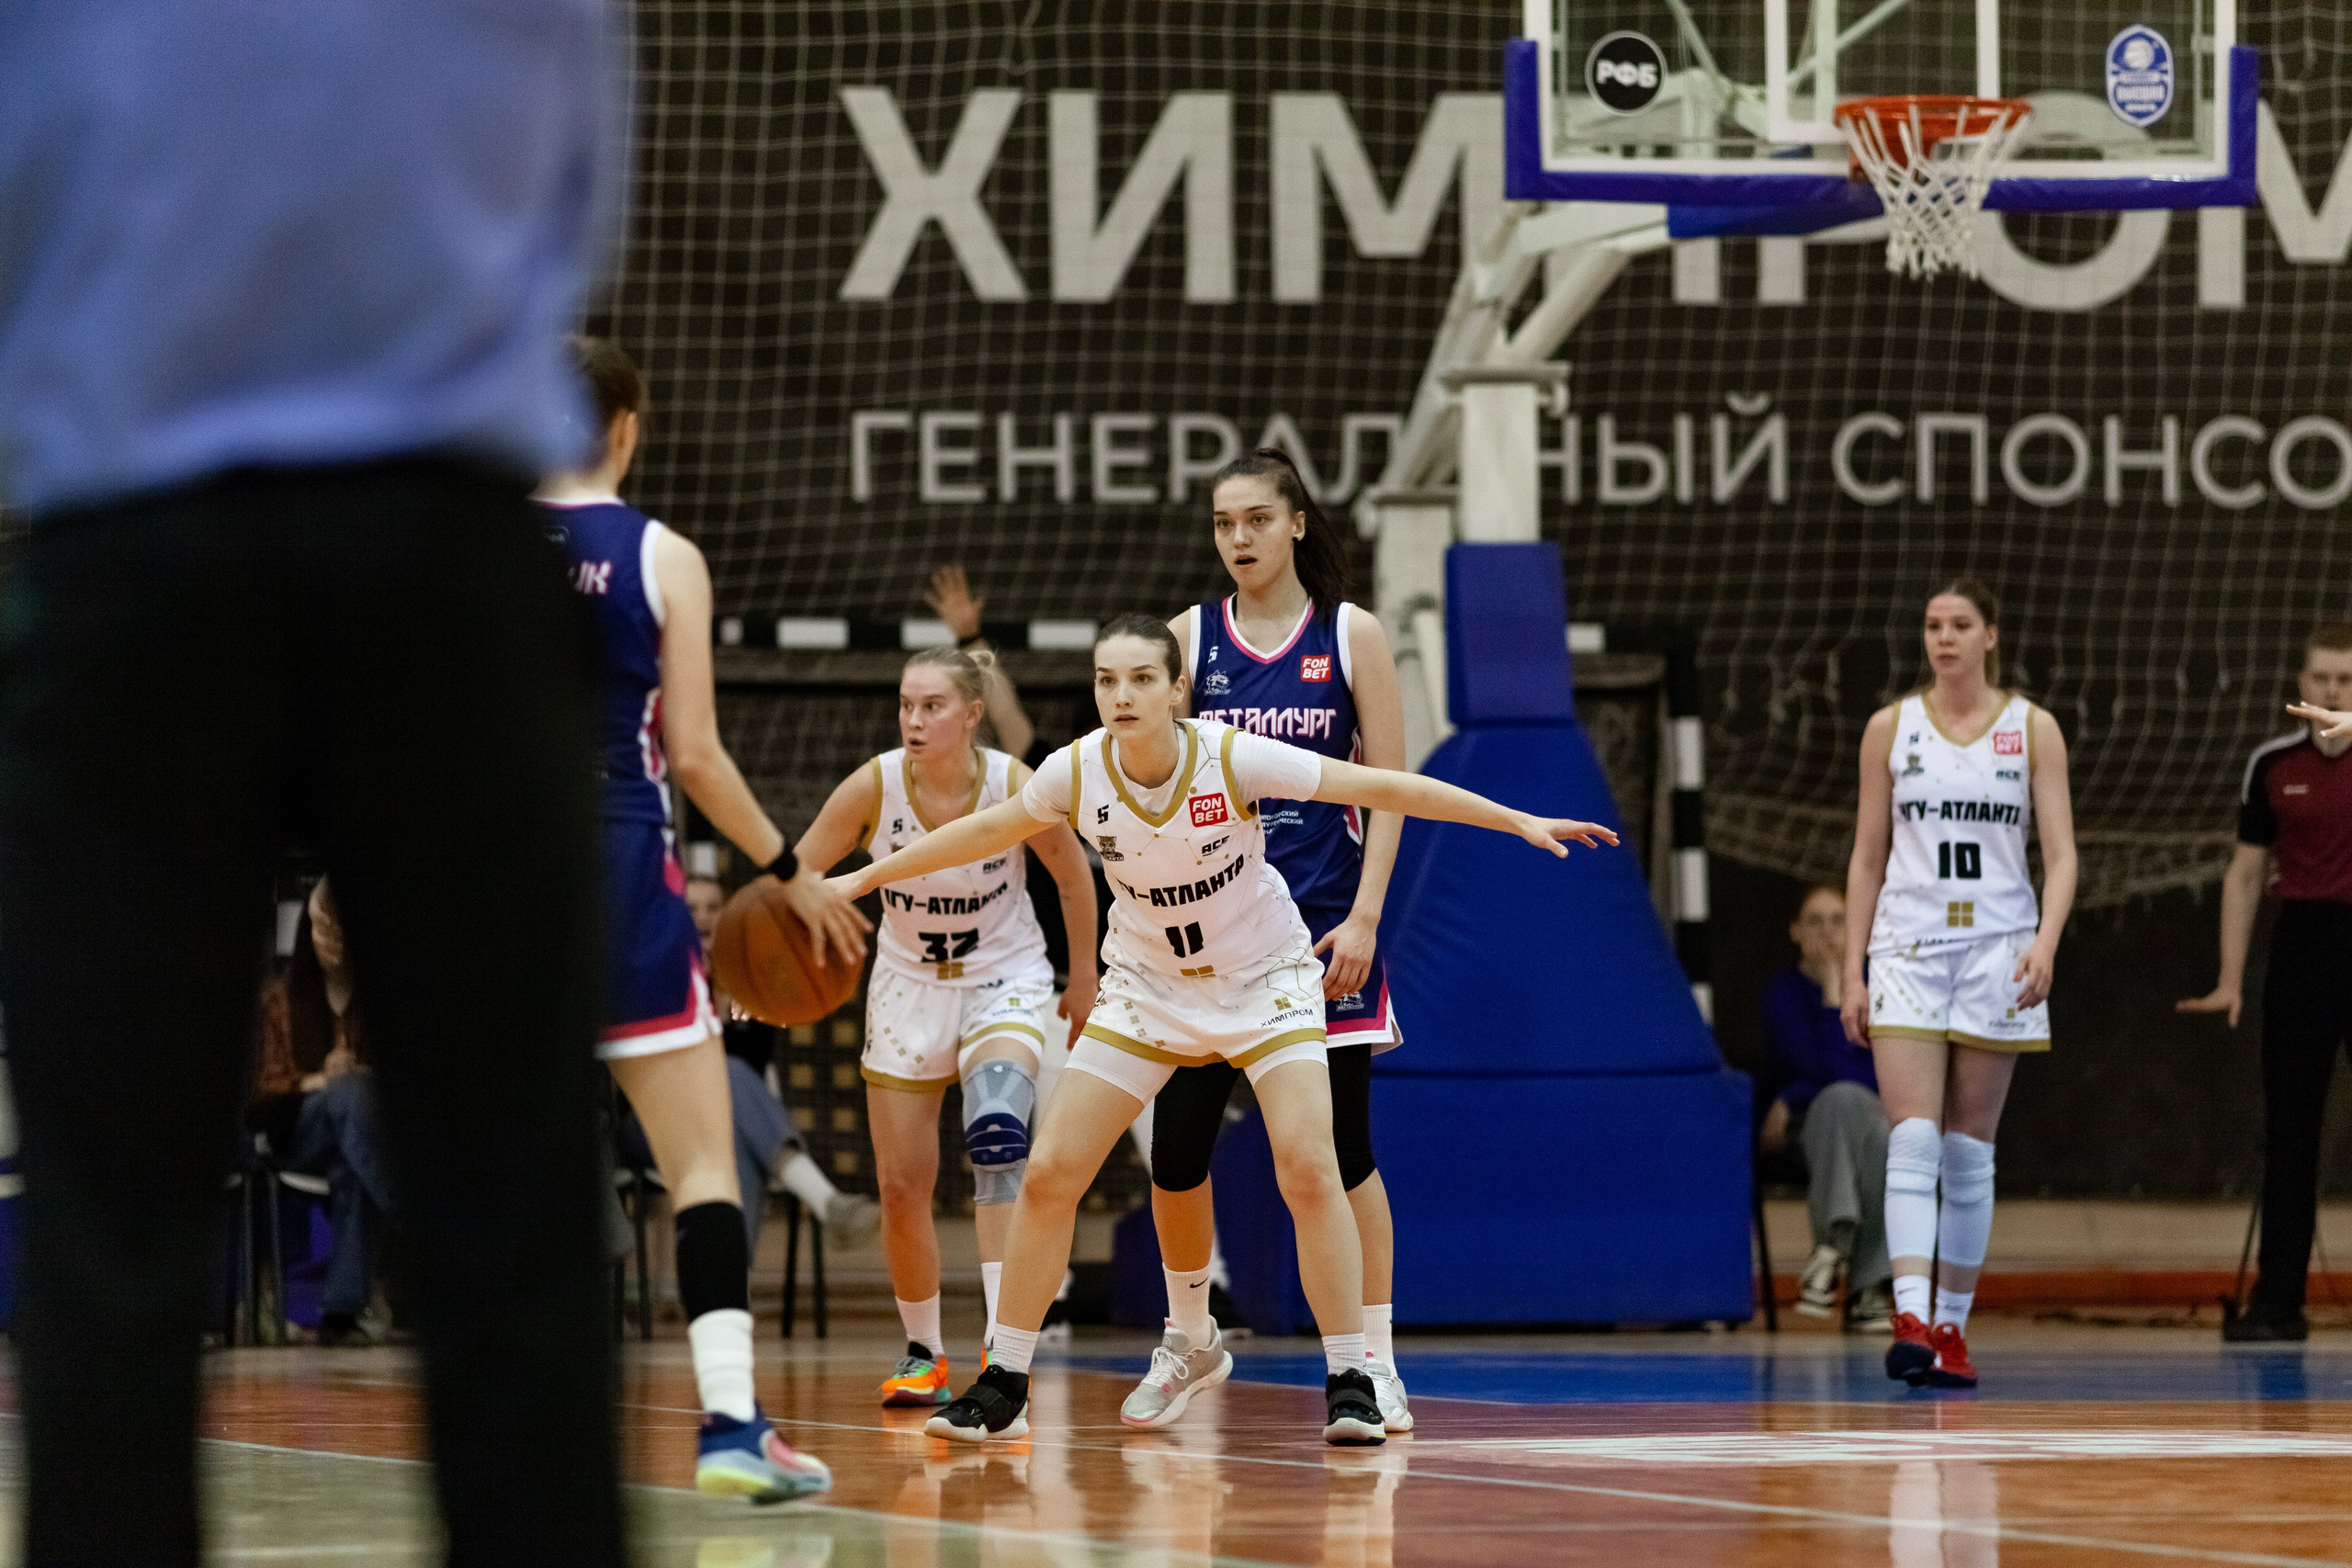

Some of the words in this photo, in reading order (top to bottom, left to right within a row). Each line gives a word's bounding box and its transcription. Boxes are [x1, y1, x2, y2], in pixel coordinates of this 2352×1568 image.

[1596, 58, 1658, 88] РФБ
[838, 85, 2352, 312] ХИМОМ
[851, 391, 1790, 505] ГЕНЕРАЛНЫЙ
[1302, 668, 1329, 680] BET
[1303, 657, 1329, 669] FON
[1193, 795, 1222, 813] FON
[1194, 807, 1225, 824] BET
[1939, 840, 1982, 880] 10
[1115, 853, 1244, 908] У-АТЛАНТА
[917, 927, 979, 964] 32
[1165, 920, 1204, 958] 11
[1260, 1008, 1314, 1028] ХИМПРОМ
